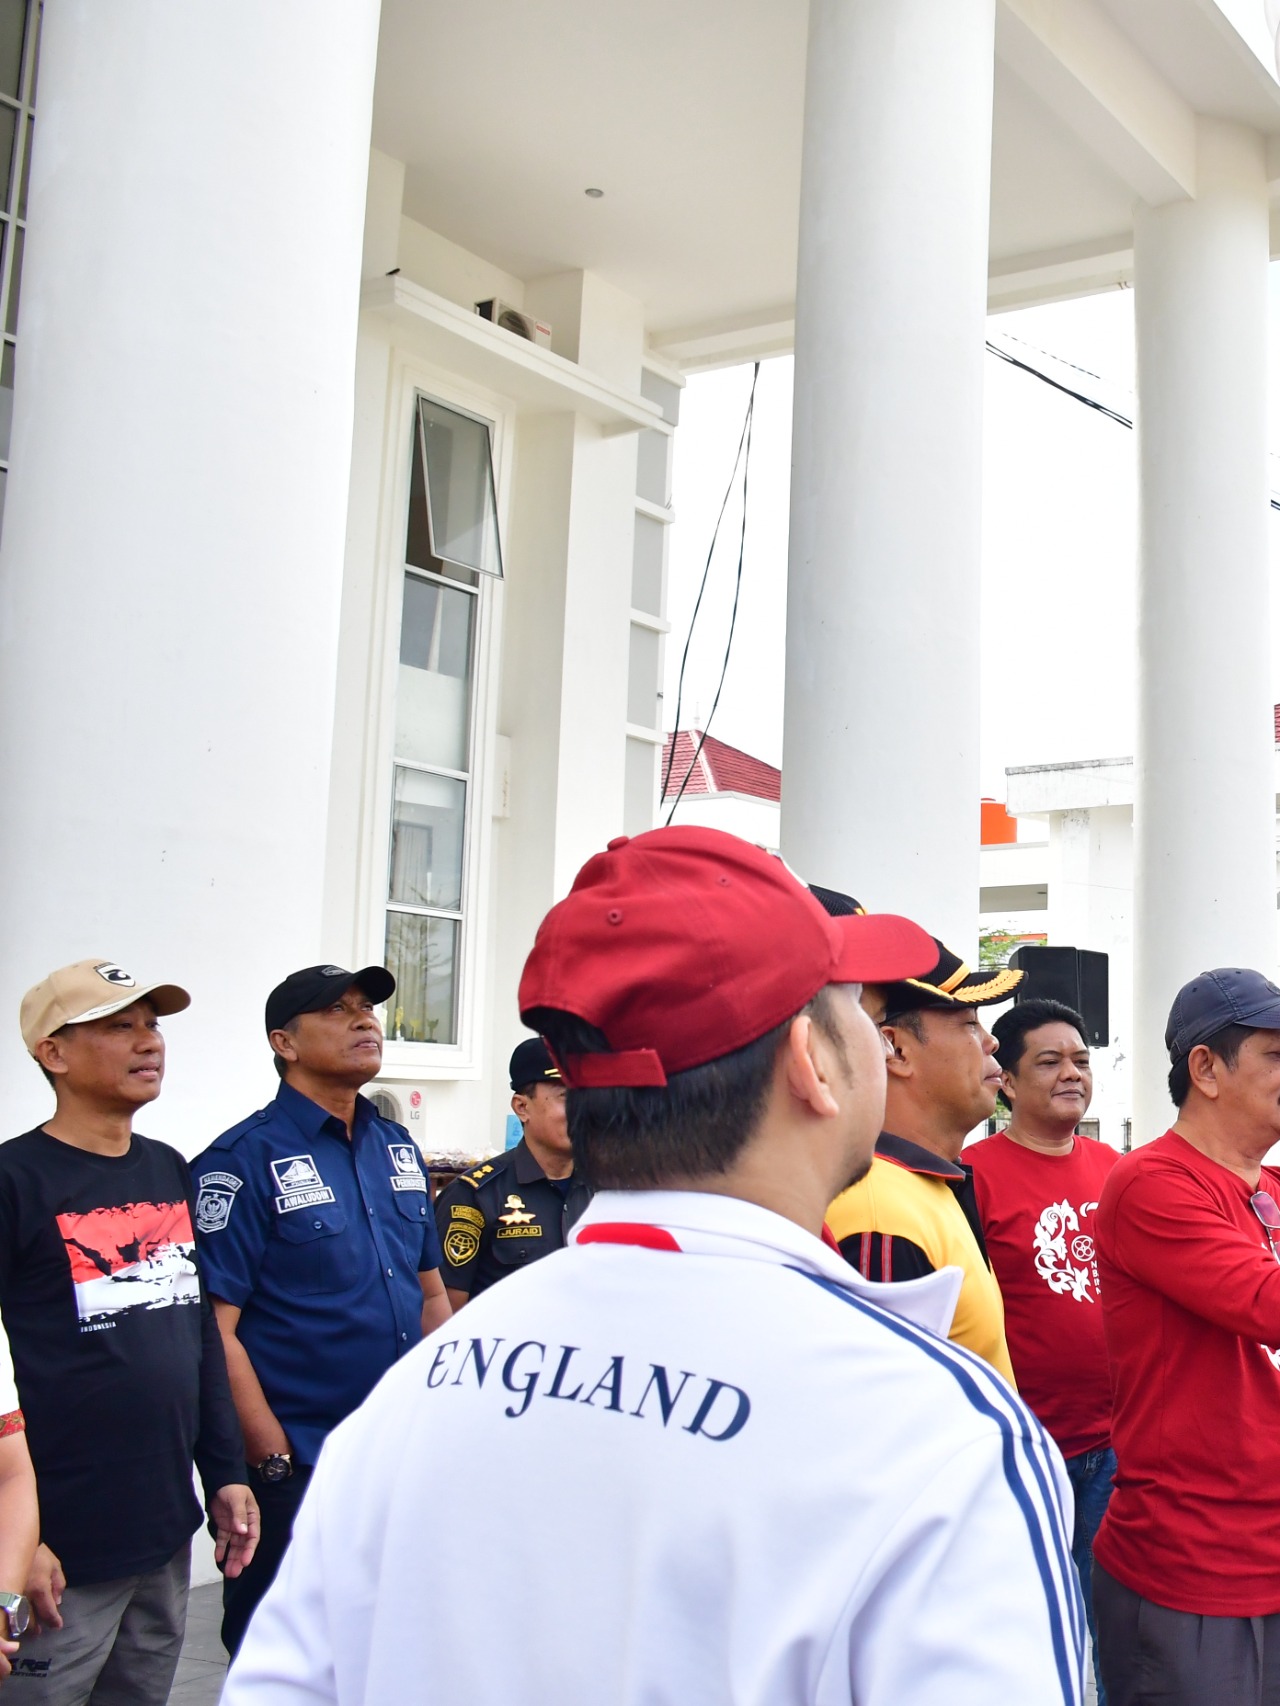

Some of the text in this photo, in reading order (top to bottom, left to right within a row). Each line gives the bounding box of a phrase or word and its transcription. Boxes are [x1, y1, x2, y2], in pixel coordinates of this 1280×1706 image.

[410, 1111, 420, 1120] LG
[284, 1190, 330, 1209] AWALUDDIN
[501, 1227, 538, 1236] JURAID
[426, 1337, 751, 1442] ENGLAND
